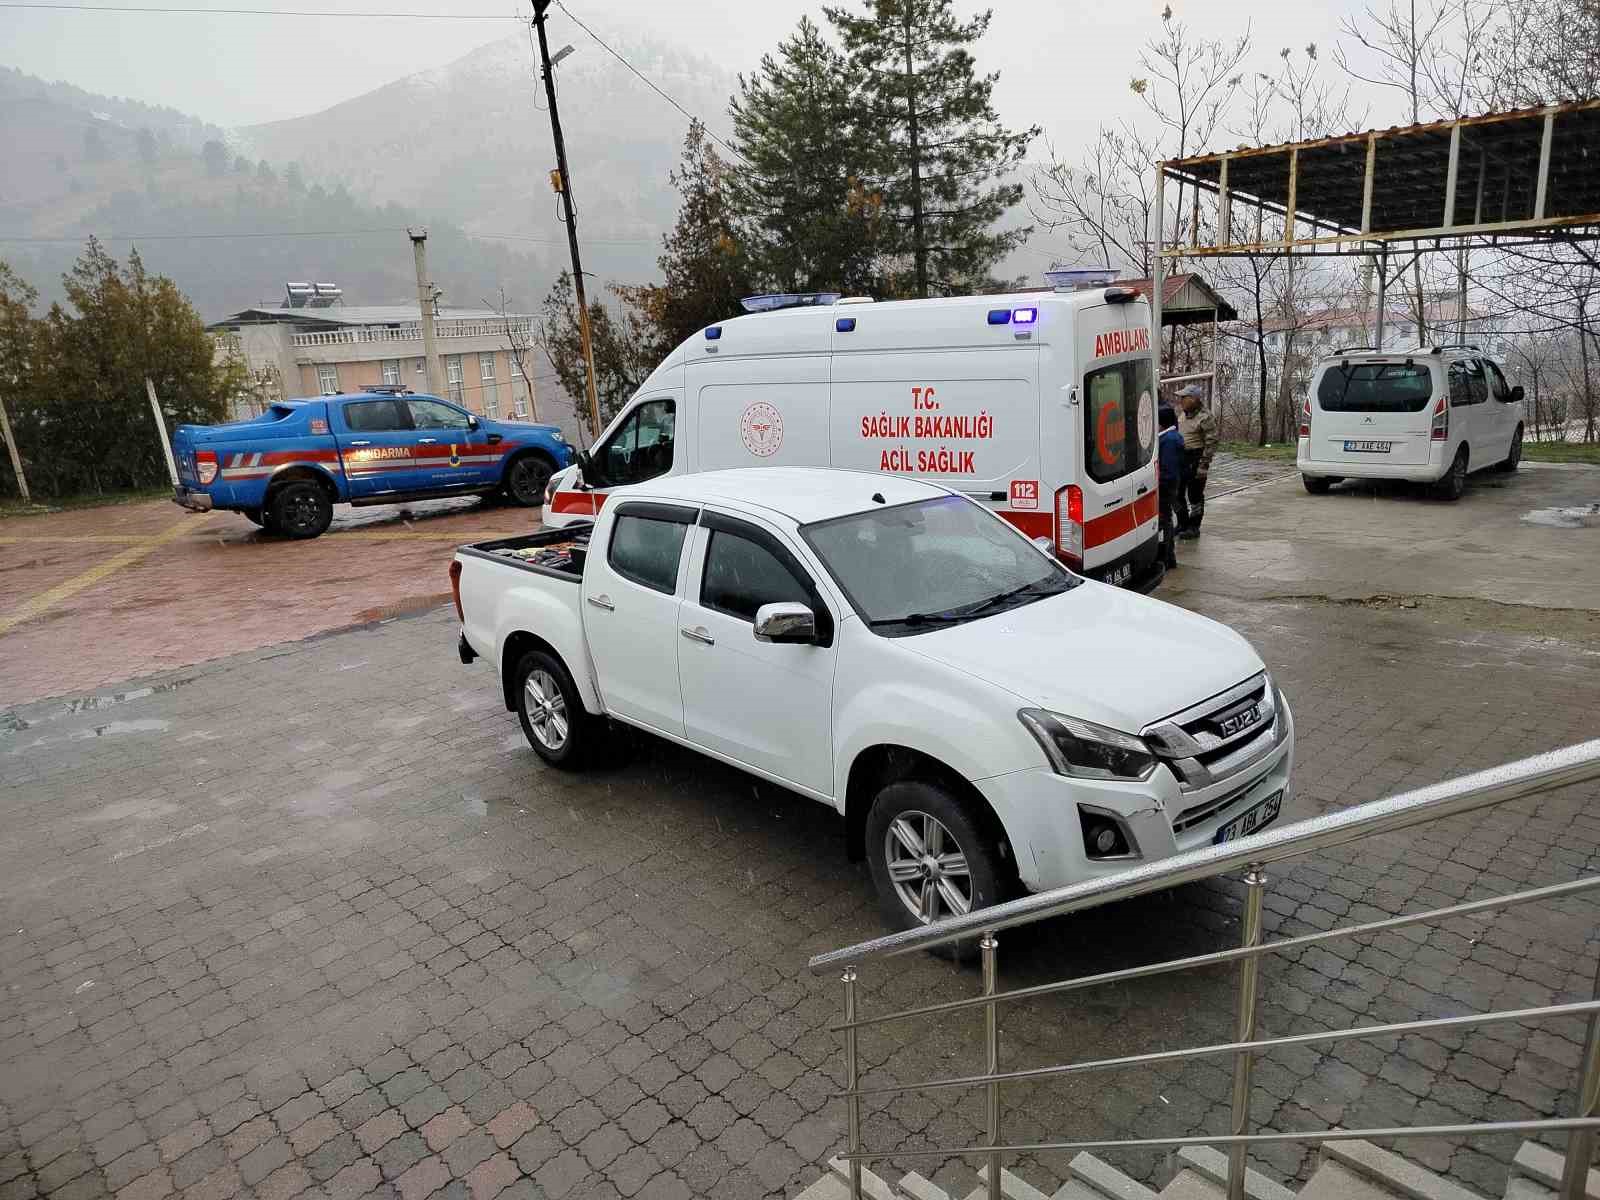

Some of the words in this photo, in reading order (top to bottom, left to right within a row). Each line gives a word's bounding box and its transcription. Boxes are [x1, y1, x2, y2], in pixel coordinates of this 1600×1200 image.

[1096, 327, 1149, 358] AMBULANS
[911, 387, 940, 409] T.C.
[861, 409, 910, 438] SAĞLIK
[915, 409, 993, 438] BAKANLIĞI
[880, 445, 913, 471] ACİL
[918, 446, 975, 473] SAĞLIK
[1014, 483, 1035, 498] 112
[1220, 705, 1261, 737] ISUZU
